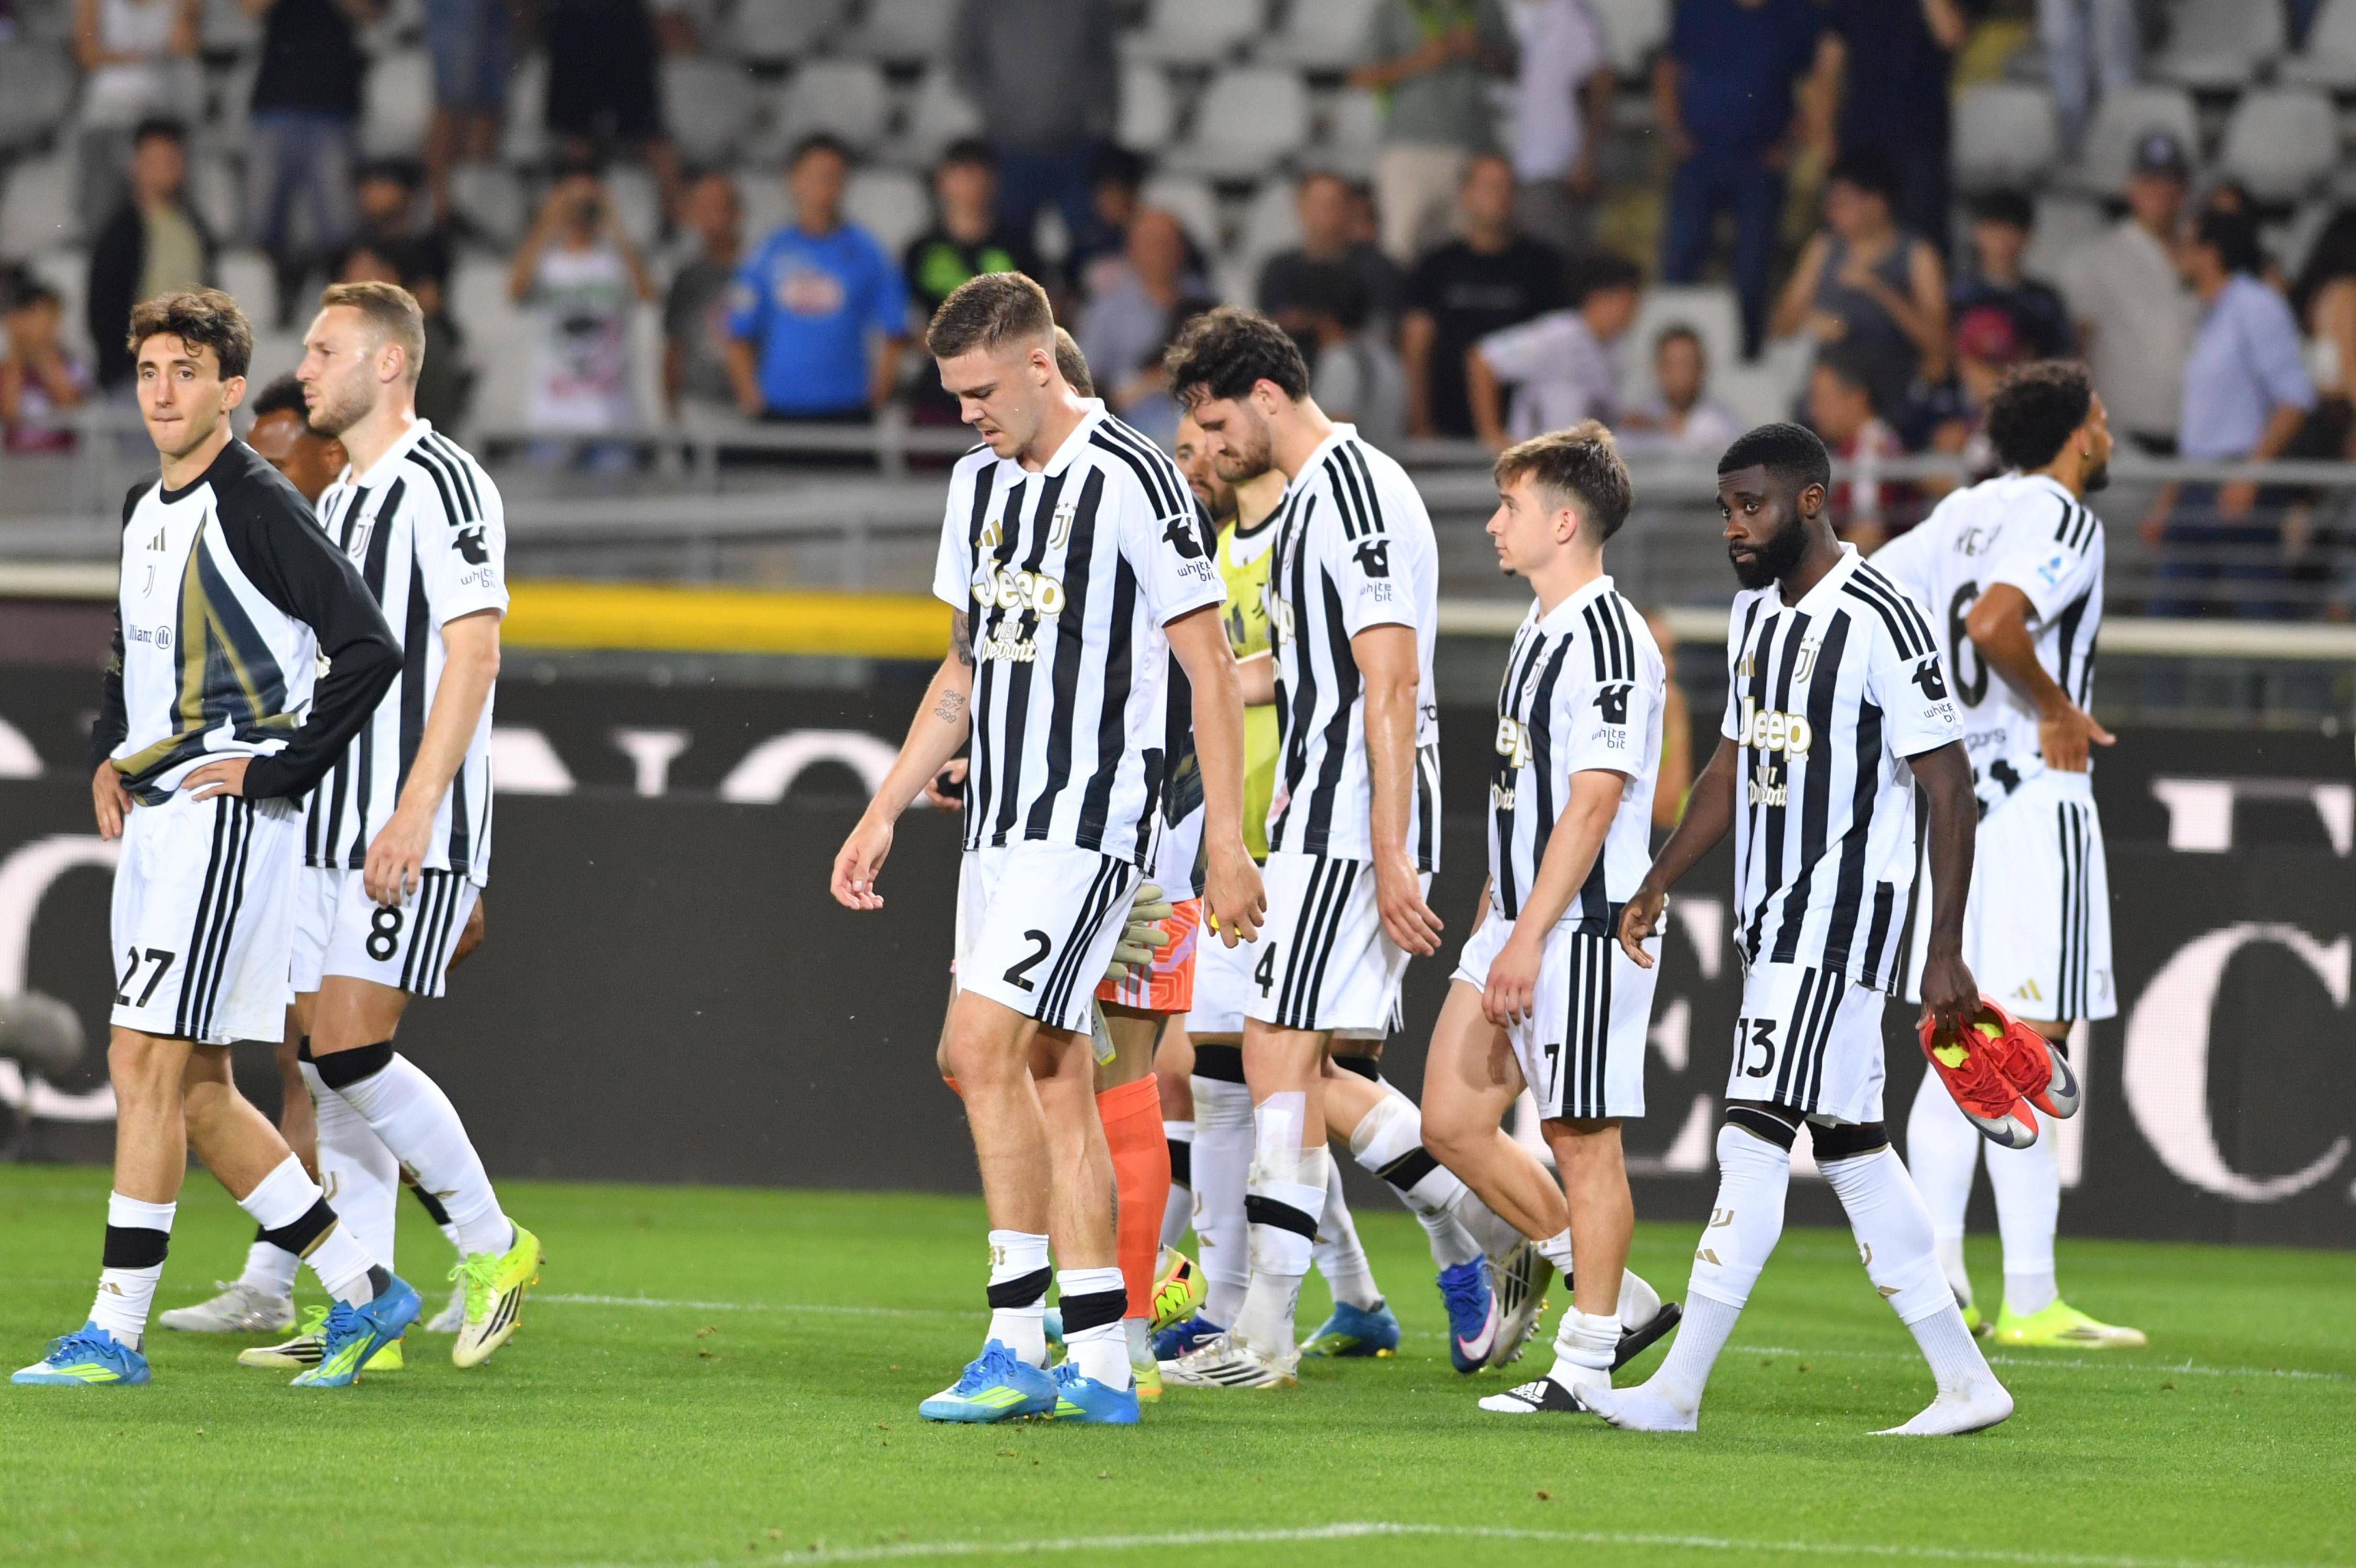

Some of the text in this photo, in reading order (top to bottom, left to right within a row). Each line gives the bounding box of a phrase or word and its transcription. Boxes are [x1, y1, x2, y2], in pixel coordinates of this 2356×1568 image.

[971, 558, 1066, 622] Jeep
[128, 624, 152, 643] llianz
[934, 708, 957, 723] 1999
[942, 690, 965, 704] 1968
[1495, 716, 1533, 769] ep
[1738, 696, 1812, 762] Jeep
[366, 905, 404, 962] 8
[1002, 929, 1052, 993] 2
[117, 945, 176, 1008] 27
[1254, 941, 1277, 998] 4
[1544, 1043, 1560, 1103] 7
[1736, 1017, 1777, 1079] 13
